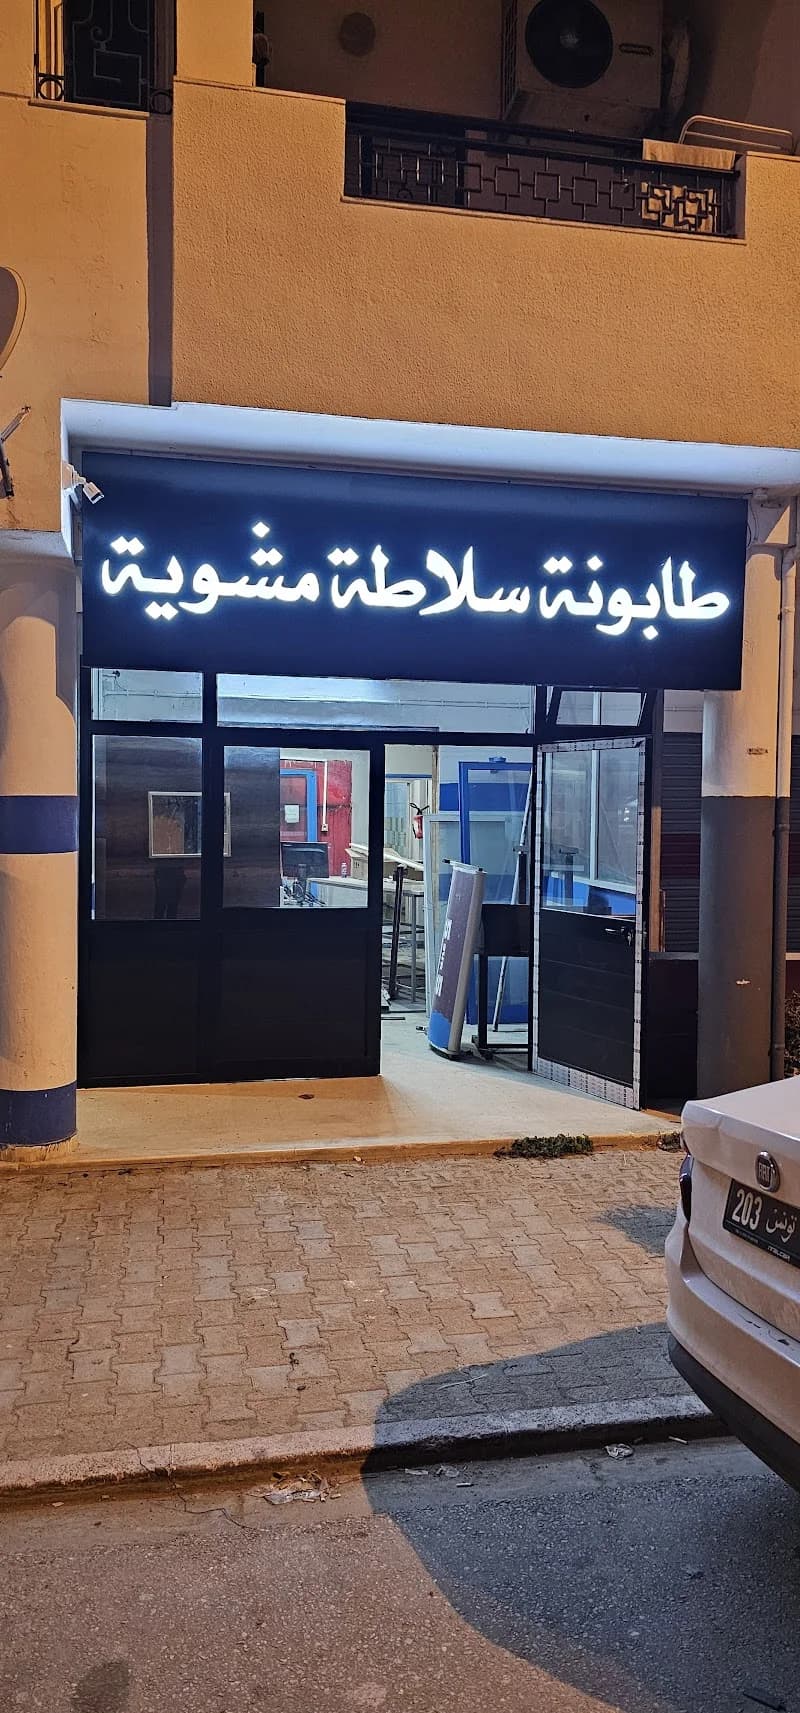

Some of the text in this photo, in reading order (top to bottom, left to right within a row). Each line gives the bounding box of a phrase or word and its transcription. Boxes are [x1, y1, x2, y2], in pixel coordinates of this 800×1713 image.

[101, 520, 731, 641] طابونة سلاطة مشوية
[731, 1189, 763, 1230] 203
[765, 1209, 798, 1243] تونس
